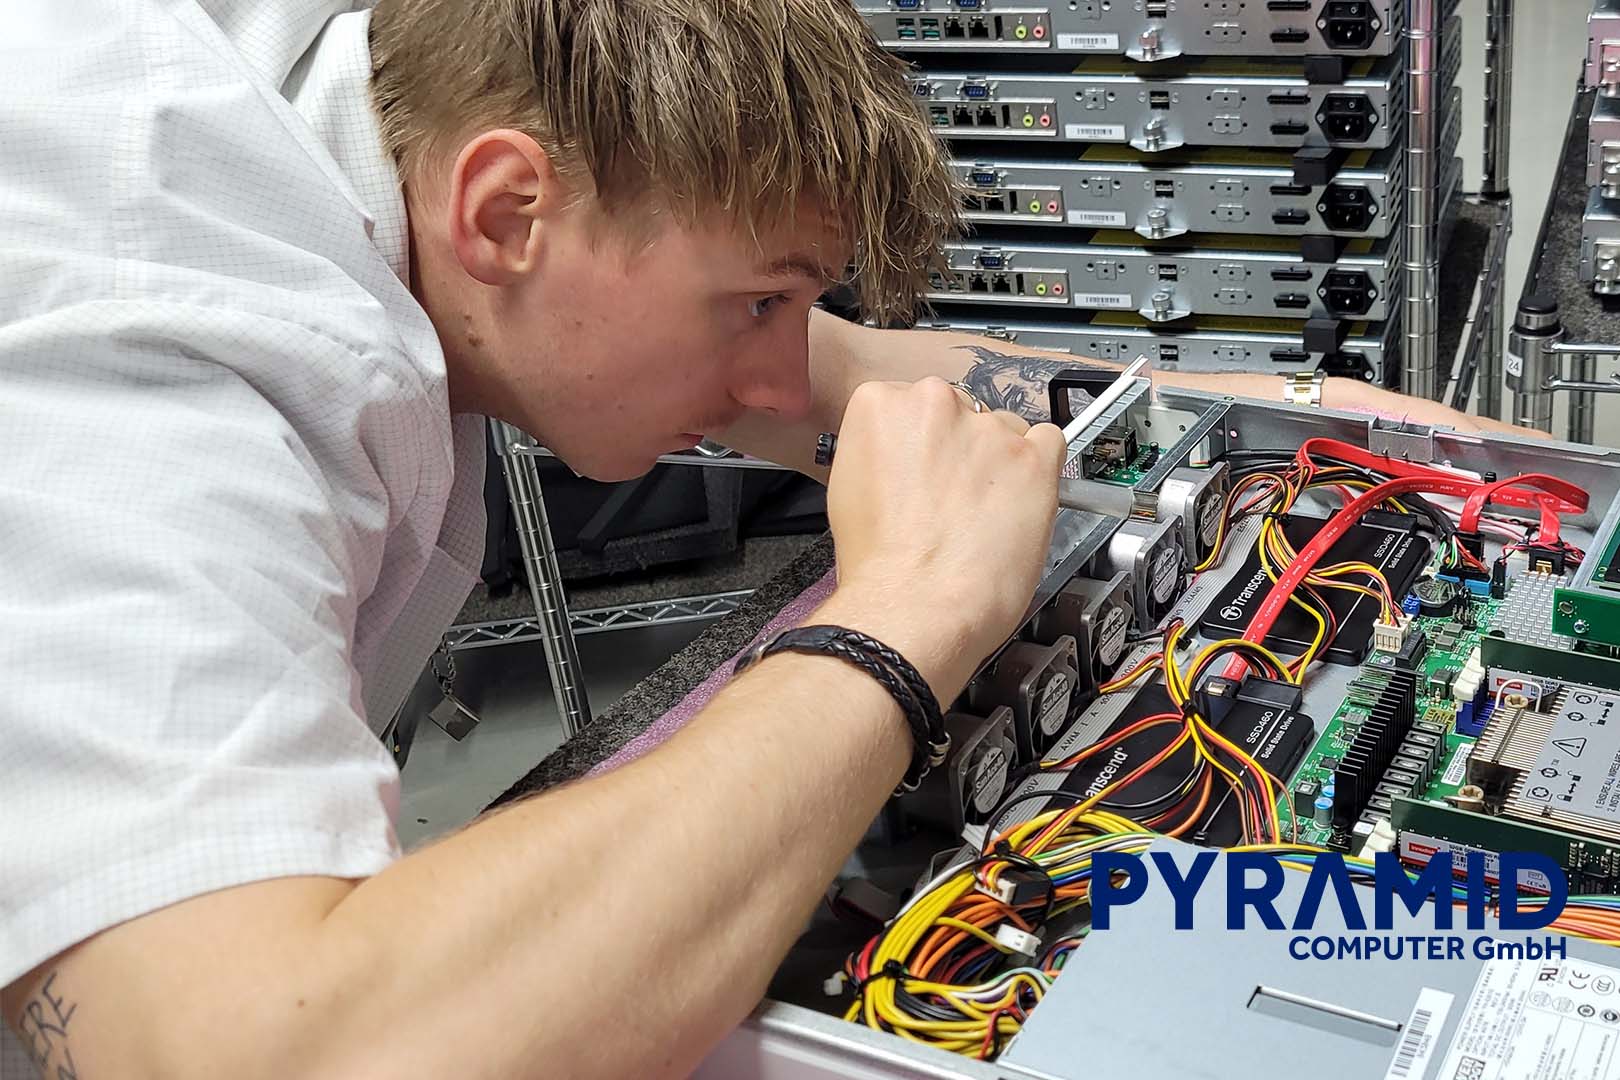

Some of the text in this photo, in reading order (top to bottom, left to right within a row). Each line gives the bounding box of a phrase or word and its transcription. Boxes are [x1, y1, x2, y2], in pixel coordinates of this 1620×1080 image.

[1374, 533, 1396, 558] SSD460
[1246, 711, 1274, 744] SSD460
[1261, 716, 1294, 760] Solid State Drive
